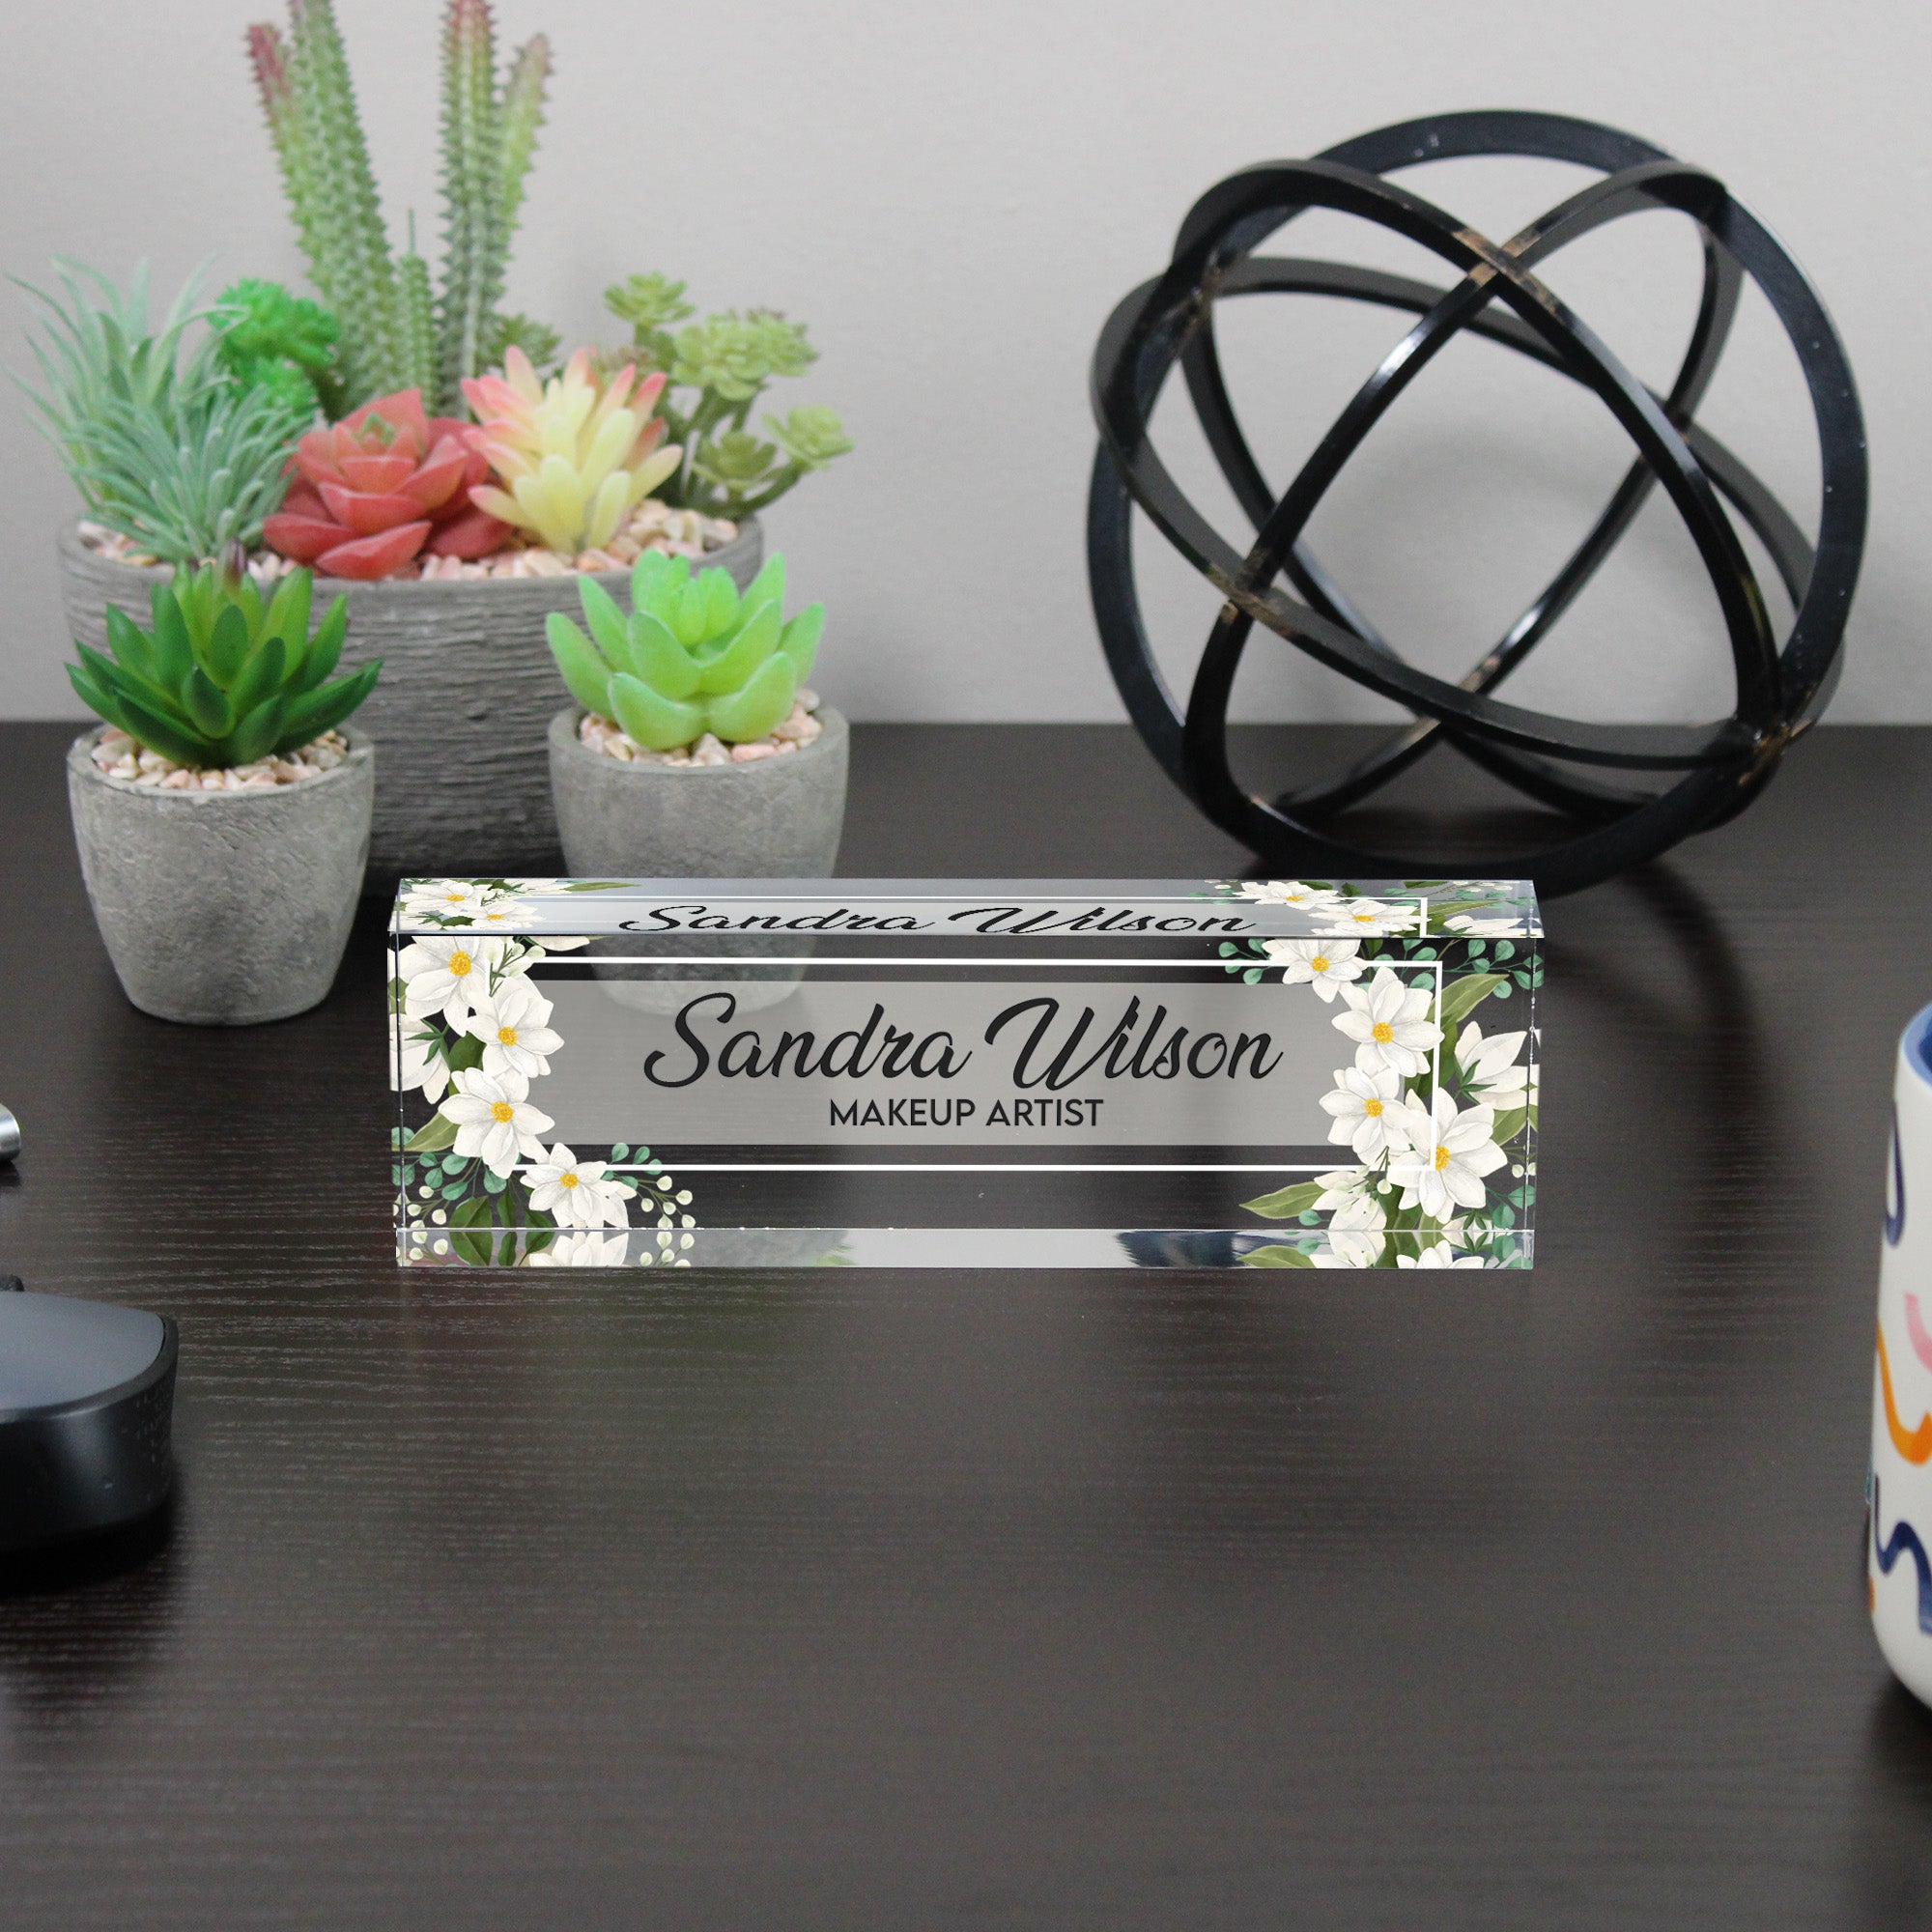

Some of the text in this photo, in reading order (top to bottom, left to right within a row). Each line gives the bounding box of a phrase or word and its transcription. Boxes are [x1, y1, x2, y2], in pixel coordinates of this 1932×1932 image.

[619, 905, 1257, 933] Sandra Wilson
[644, 993, 1283, 1091] Sandra Wilson
[831, 1099, 1103, 1126] MAKEUP ARTIST
